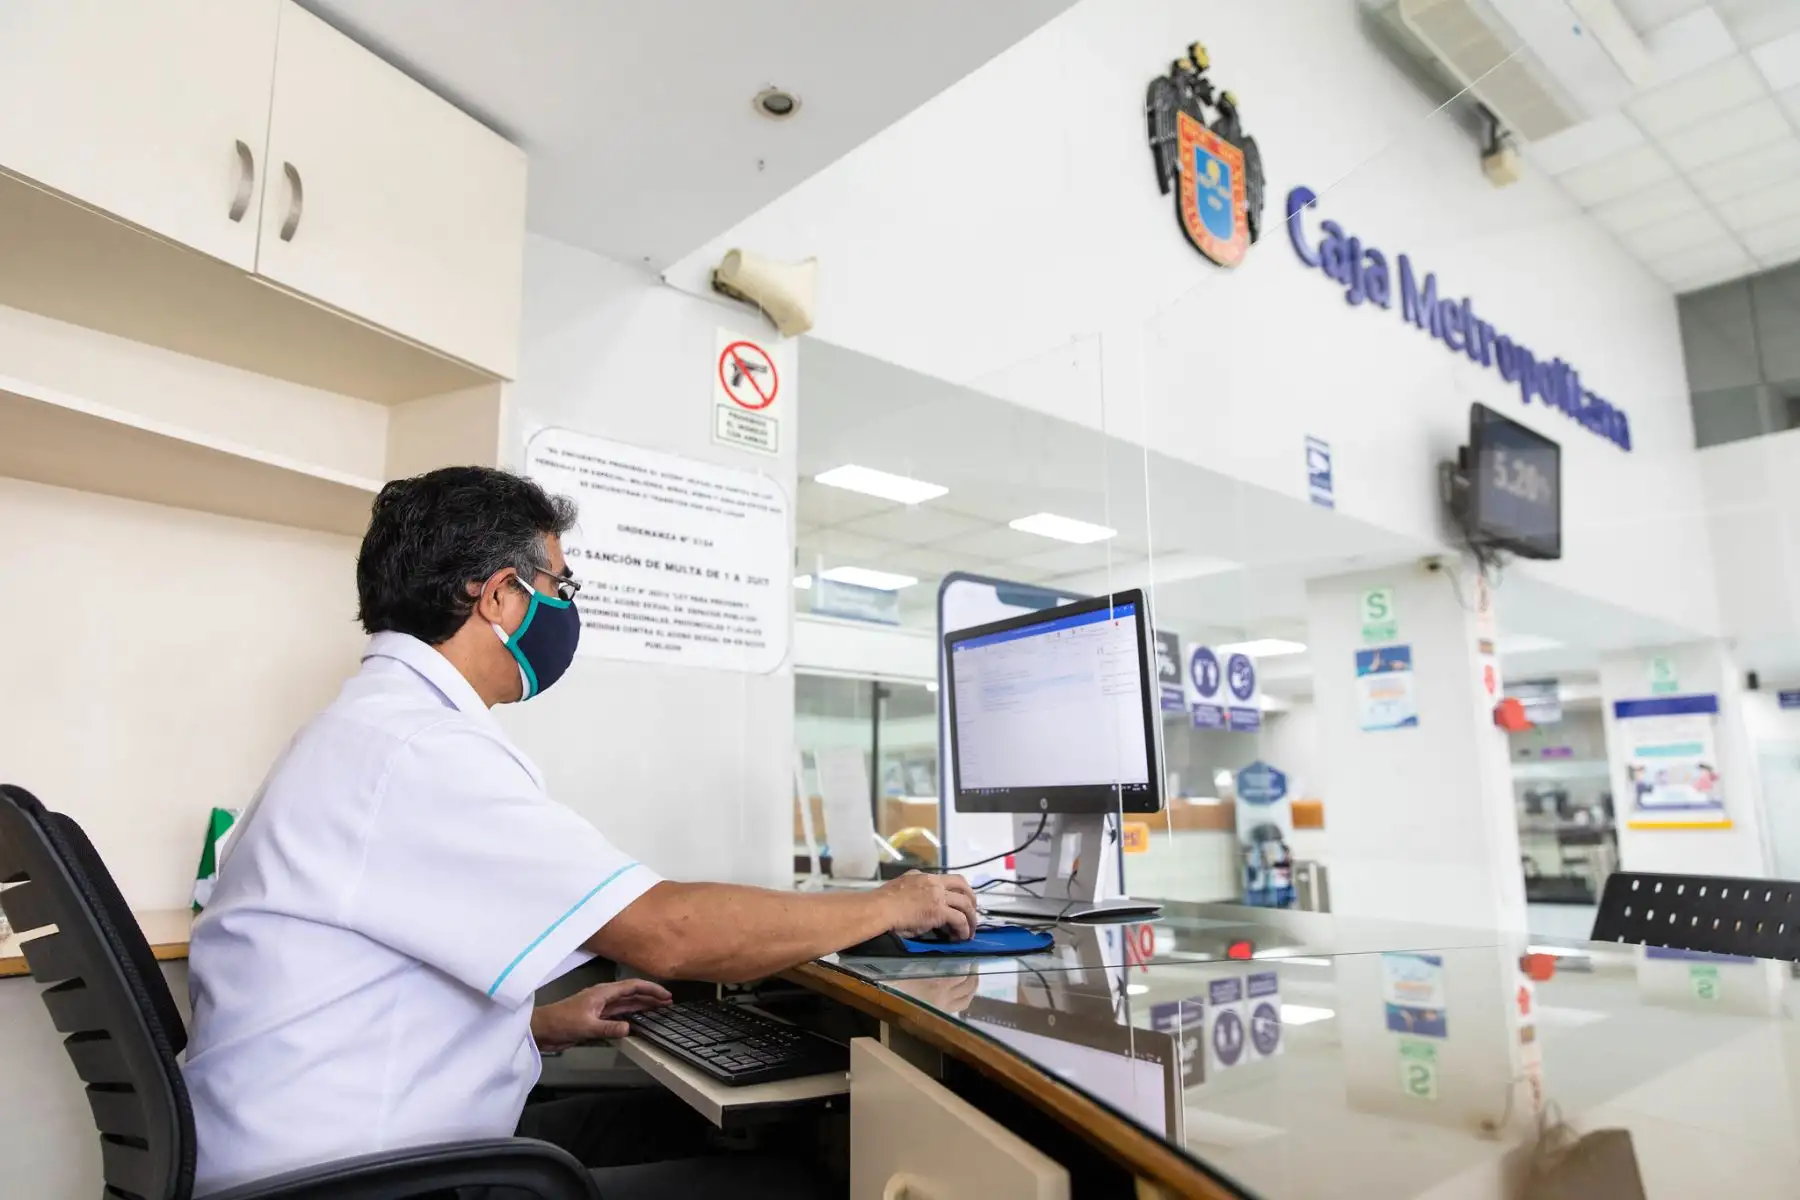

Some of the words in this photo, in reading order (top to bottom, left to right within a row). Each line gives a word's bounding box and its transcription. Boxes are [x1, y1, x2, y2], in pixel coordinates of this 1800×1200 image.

[1286, 186, 1391, 310] Caja
[1398, 253, 1632, 453] Metropolitana
[617, 523, 676, 541] ORDENANZA
[564, 545, 581, 557] JO
[585, 549, 641, 568] SANCIÓN
[645, 559, 660, 569] DE
[665, 561, 702, 576] MULTA
[706, 568, 720, 579] DE
[733, 573, 740, 582] A
[1367, 593, 1388, 619] S
